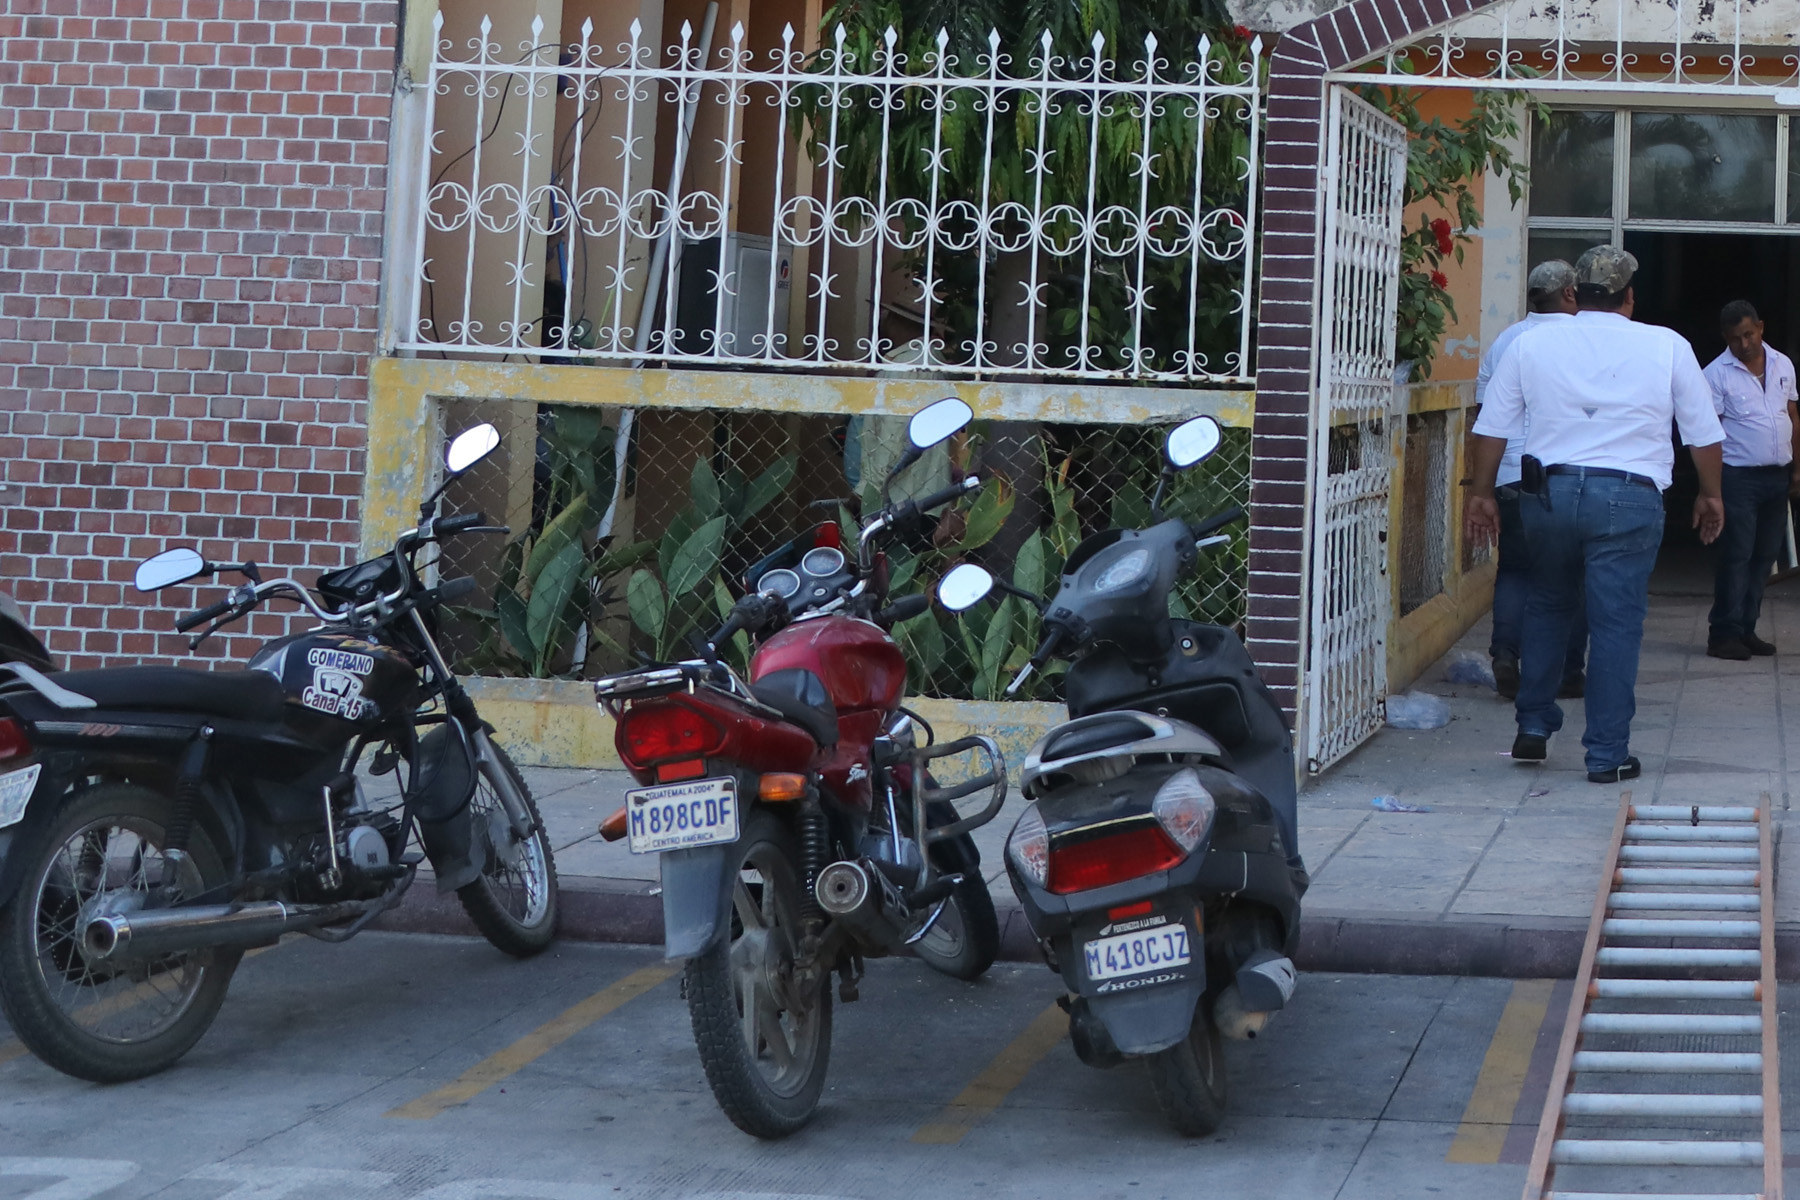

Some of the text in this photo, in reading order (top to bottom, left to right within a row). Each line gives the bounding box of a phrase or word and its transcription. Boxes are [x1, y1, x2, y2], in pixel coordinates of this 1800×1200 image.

[310, 650, 373, 673] GOMERANO
[322, 672, 351, 696] TV
[303, 688, 362, 718] Canal 15
[649, 784, 712, 800] GUATEMALA 2004
[652, 836, 680, 848] CENTRO
[1111, 972, 1186, 991] HONDA
